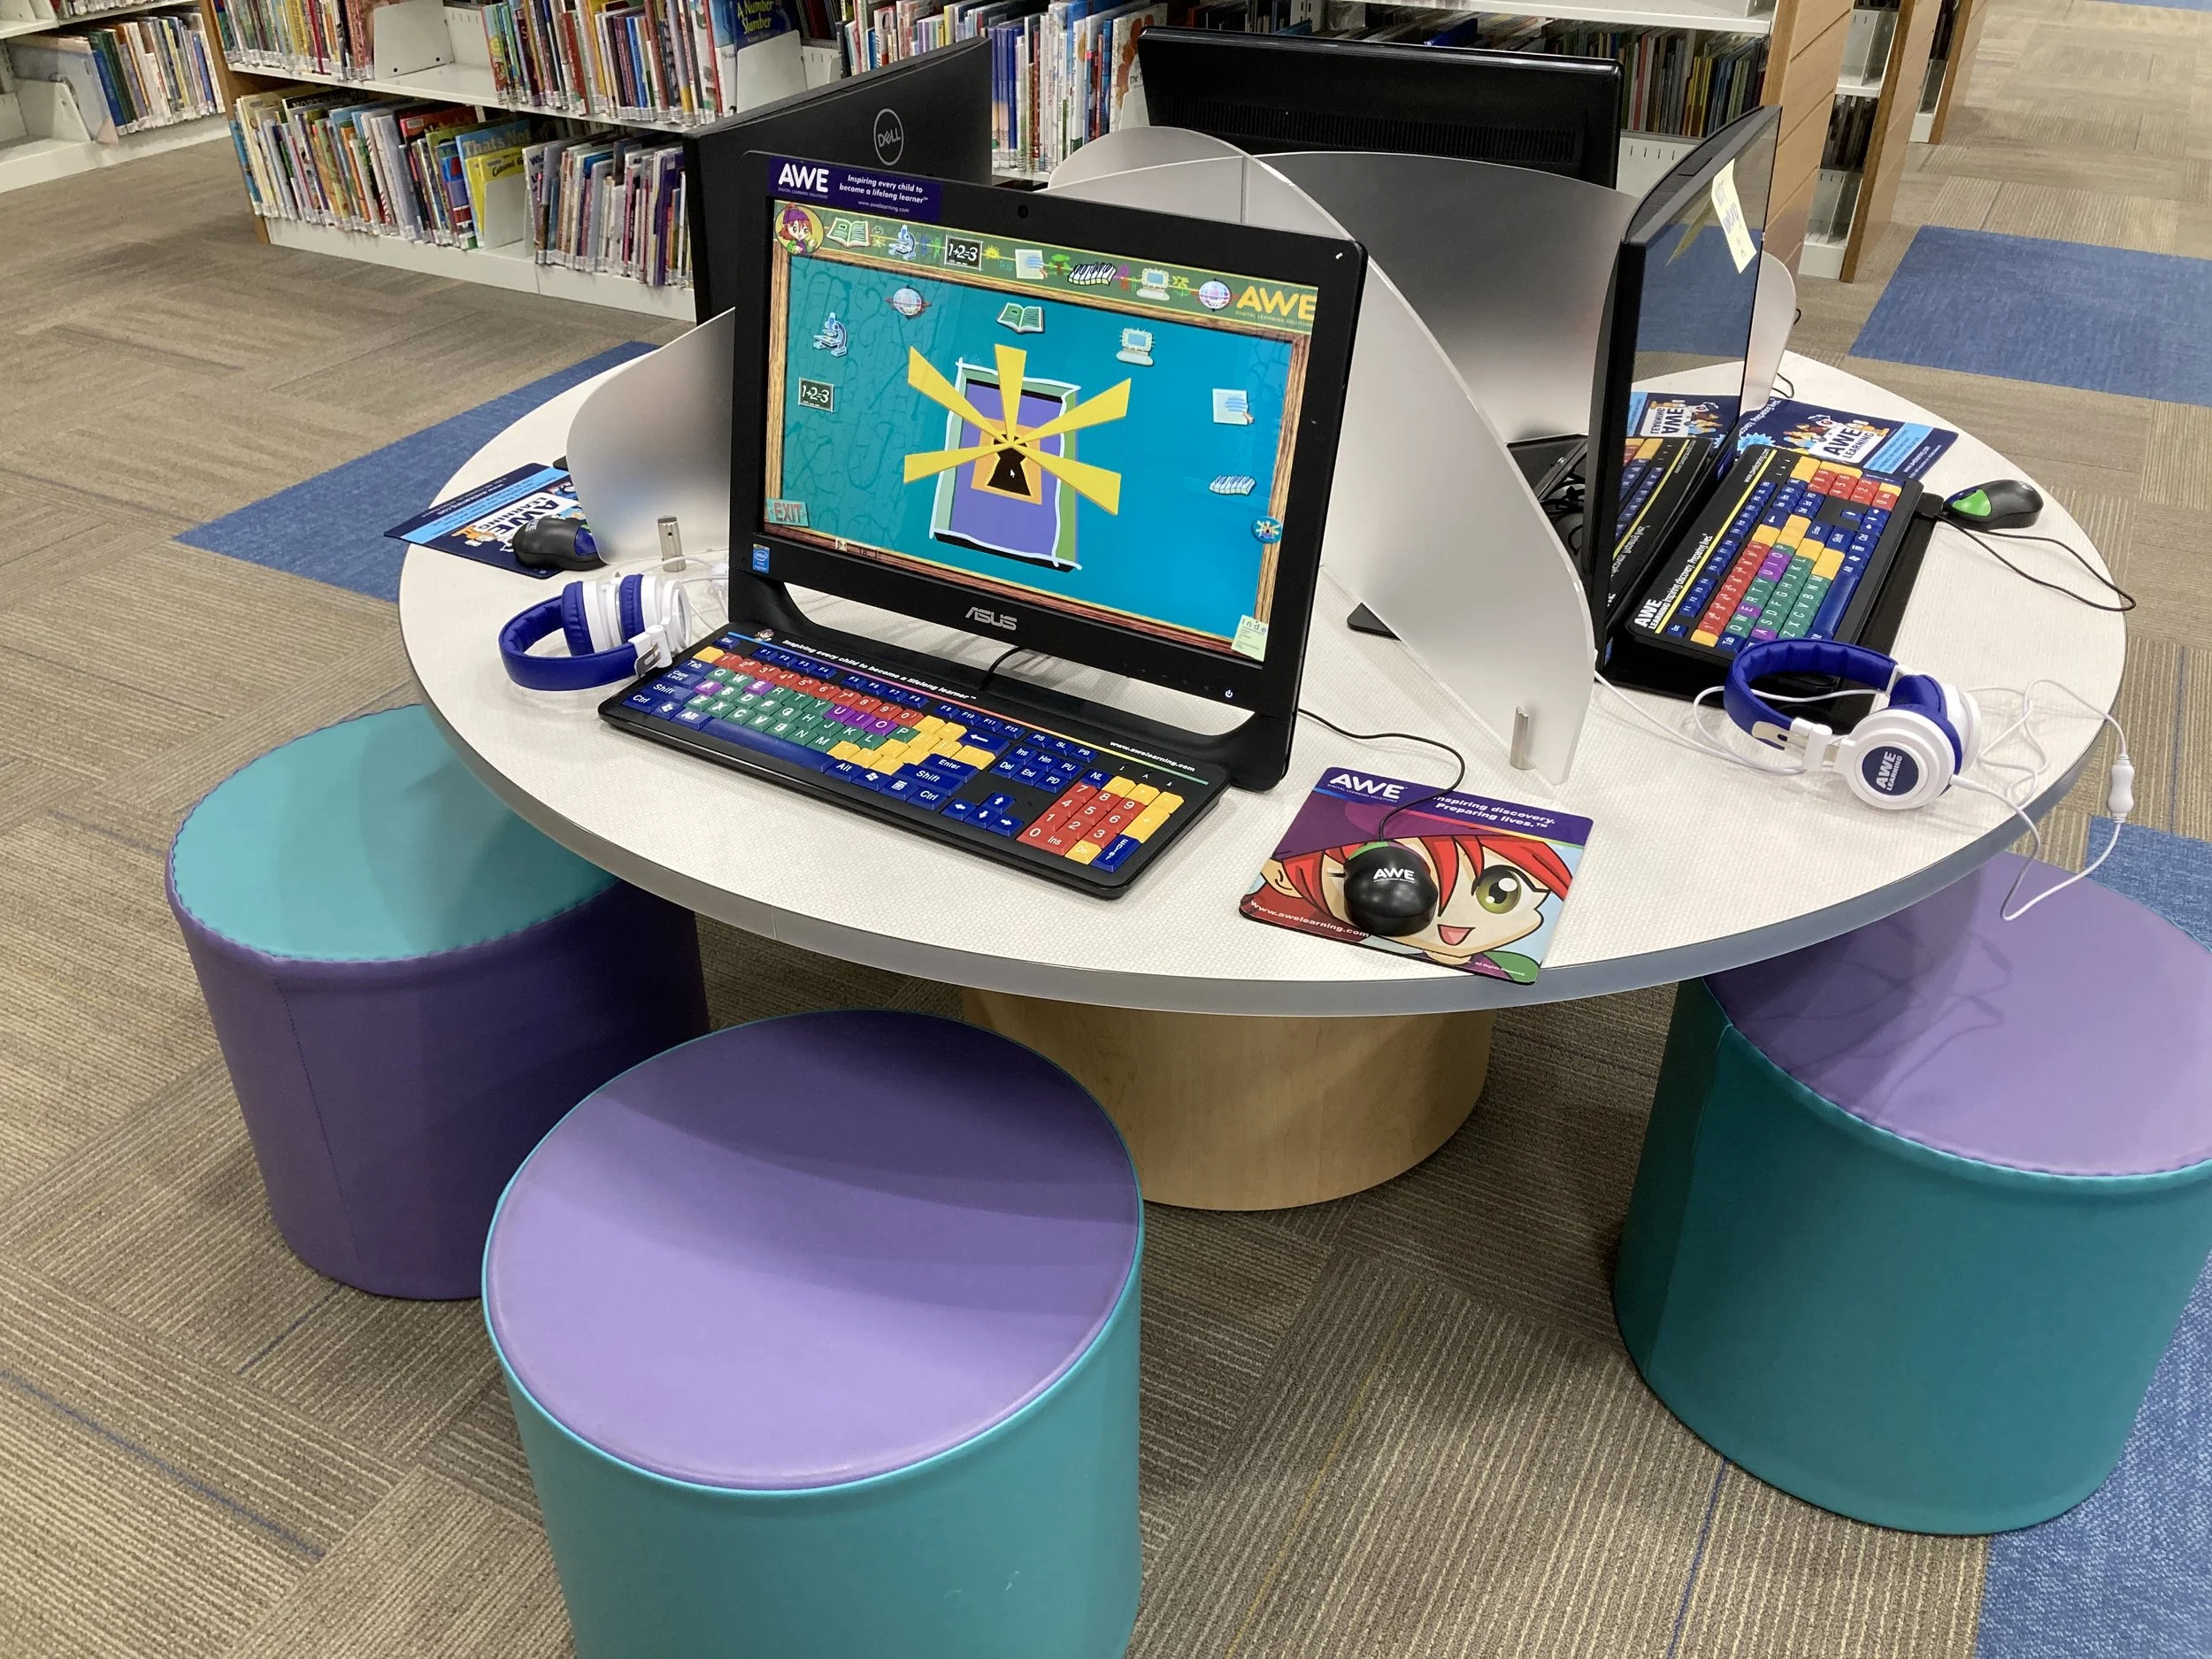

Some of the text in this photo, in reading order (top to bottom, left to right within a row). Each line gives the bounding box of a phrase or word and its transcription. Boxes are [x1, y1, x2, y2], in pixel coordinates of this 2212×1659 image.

[743, 12, 772, 35] Slumber
[878, 127, 901, 148] DELL
[779, 163, 829, 193] AWE
[848, 174, 877, 188] Inspiring
[878, 180, 896, 190] every
[897, 182, 915, 192] child
[839, 183, 865, 195] become
[872, 188, 897, 201] lifelong
[1237, 286, 1317, 320] AWE
[1823, 428, 1863, 455] AWE
[1842, 432, 1874, 458] LEARNING
[479, 497, 547, 529] LEARNING
[488, 499, 560, 534] AWE
[773, 502, 801, 524] EXIT
[1635, 599, 1663, 627] AWE
[1648, 602, 1671, 630] LEARNING
[965, 607, 1018, 631] ASUS
[687, 660, 703, 669] Tab
[782, 640, 816, 654] Inspiring
[816, 650, 839, 660] every
[839, 657, 859, 665] child
[858, 660, 867, 669] to
[868, 665, 901, 678] become
[908, 678, 938, 690] lifelong
[733, 674, 747, 683] W
[653, 684, 674, 695] Shift
[633, 695, 651, 704] Ctrl
[693, 695, 708, 704] Z
[711, 701, 727, 711] X
[834, 706, 846, 715] U
[681, 710, 699, 720] Alt
[733, 709, 747, 718] C
[802, 713, 816, 722] H
[774, 723, 787, 733] B
[842, 727, 856, 736] K
[816, 736, 830, 745] M
[864, 734, 873, 743] L
[1110, 741, 1196, 772] www.awelearning.com
[836, 763, 851, 772] Alt
[938, 759, 961, 770] Enter
[999, 761, 1013, 771] Del
[1062, 763, 1076, 772] PU
[1876, 751, 1897, 789] AWE
[917, 770, 941, 782] Shift
[1021, 769, 1037, 778] End
[1090, 772, 1102, 780] NL
[1886, 756, 1902, 791] LEARNING
[1330, 773, 1405, 800] AWE
[920, 791, 939, 802] Ctrl
[1099, 793, 1110, 802] 8
[1346, 788, 1370, 798] LEARNING
[1084, 806, 1096, 815] 5
[1124, 801, 1135, 810] 9
[1435, 803, 1499, 821] Preparing
[1491, 806, 1555, 825] discovery.
[1109, 815, 1120, 824] 6
[1067, 821, 1081, 830] 2
[1030, 828, 1062, 846] 0 Ins
[1094, 830, 1106, 839] 3
[1373, 867, 1416, 881] AWE
[1250, 899, 1370, 938] www.awelearning.com
